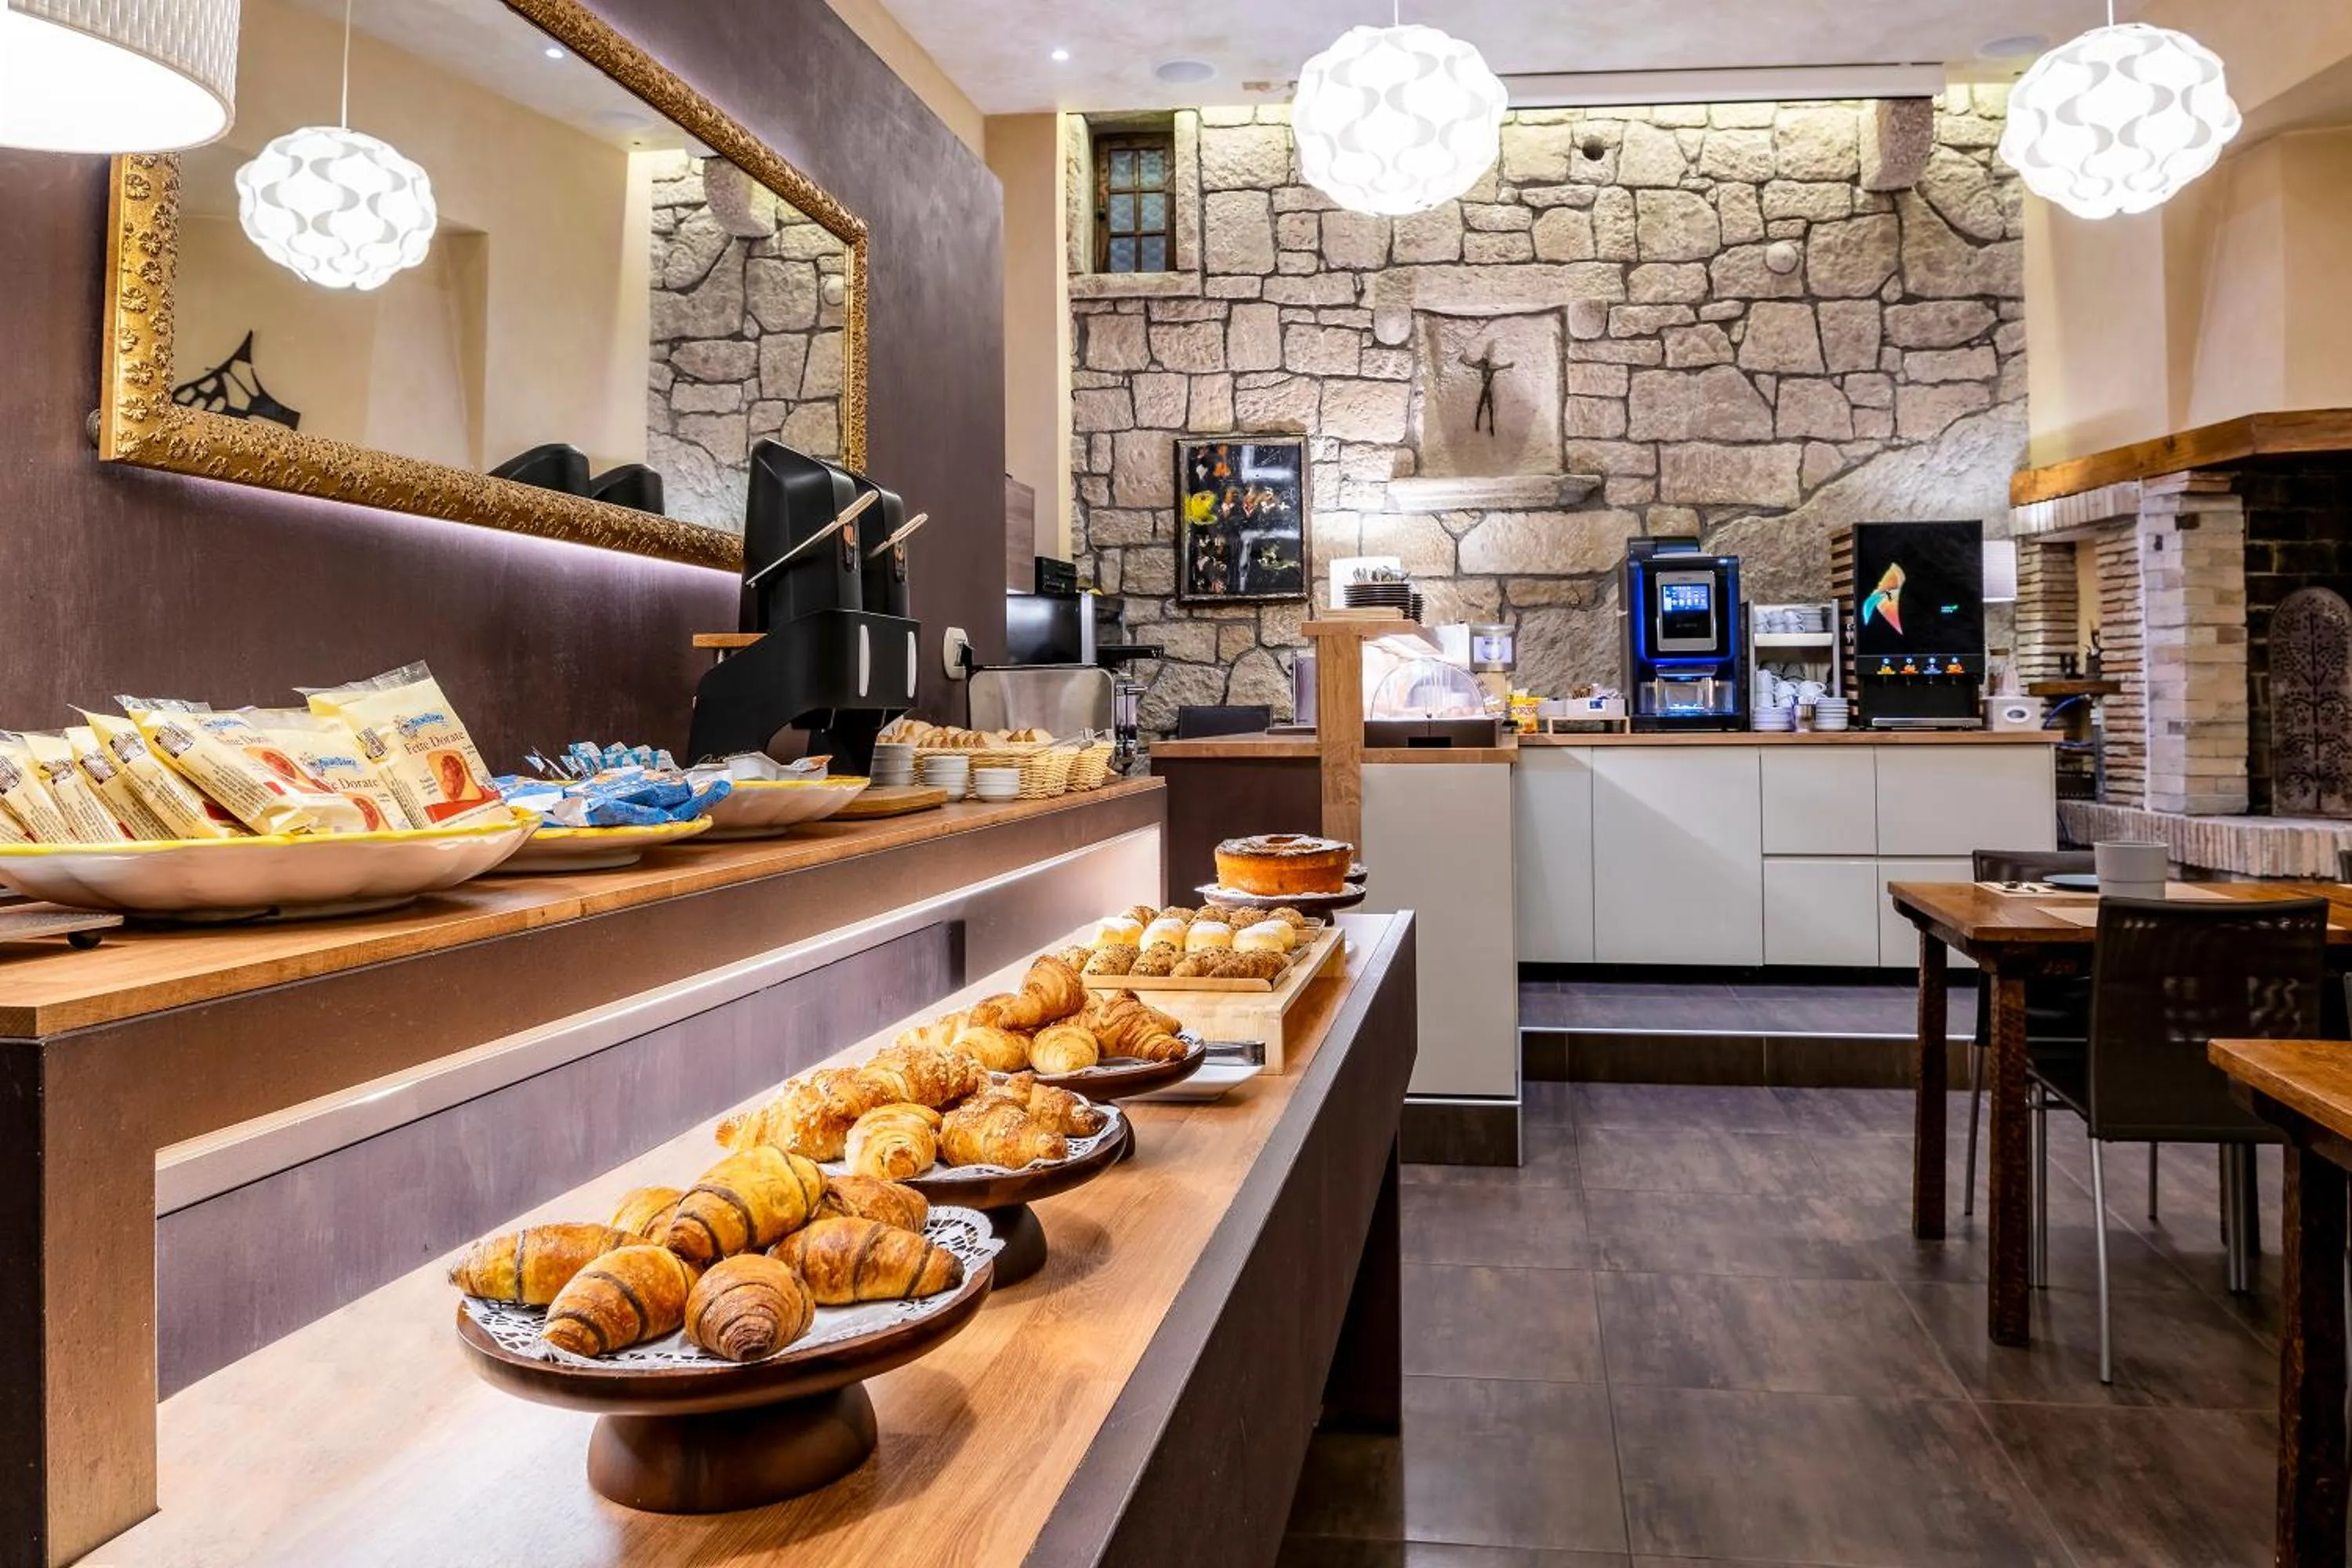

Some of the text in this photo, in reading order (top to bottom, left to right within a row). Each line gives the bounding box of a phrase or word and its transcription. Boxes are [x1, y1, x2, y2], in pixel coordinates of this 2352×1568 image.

[403, 741, 430, 755] Fette
[429, 731, 466, 747] Dorate
[338, 778, 379, 789] Dorate
